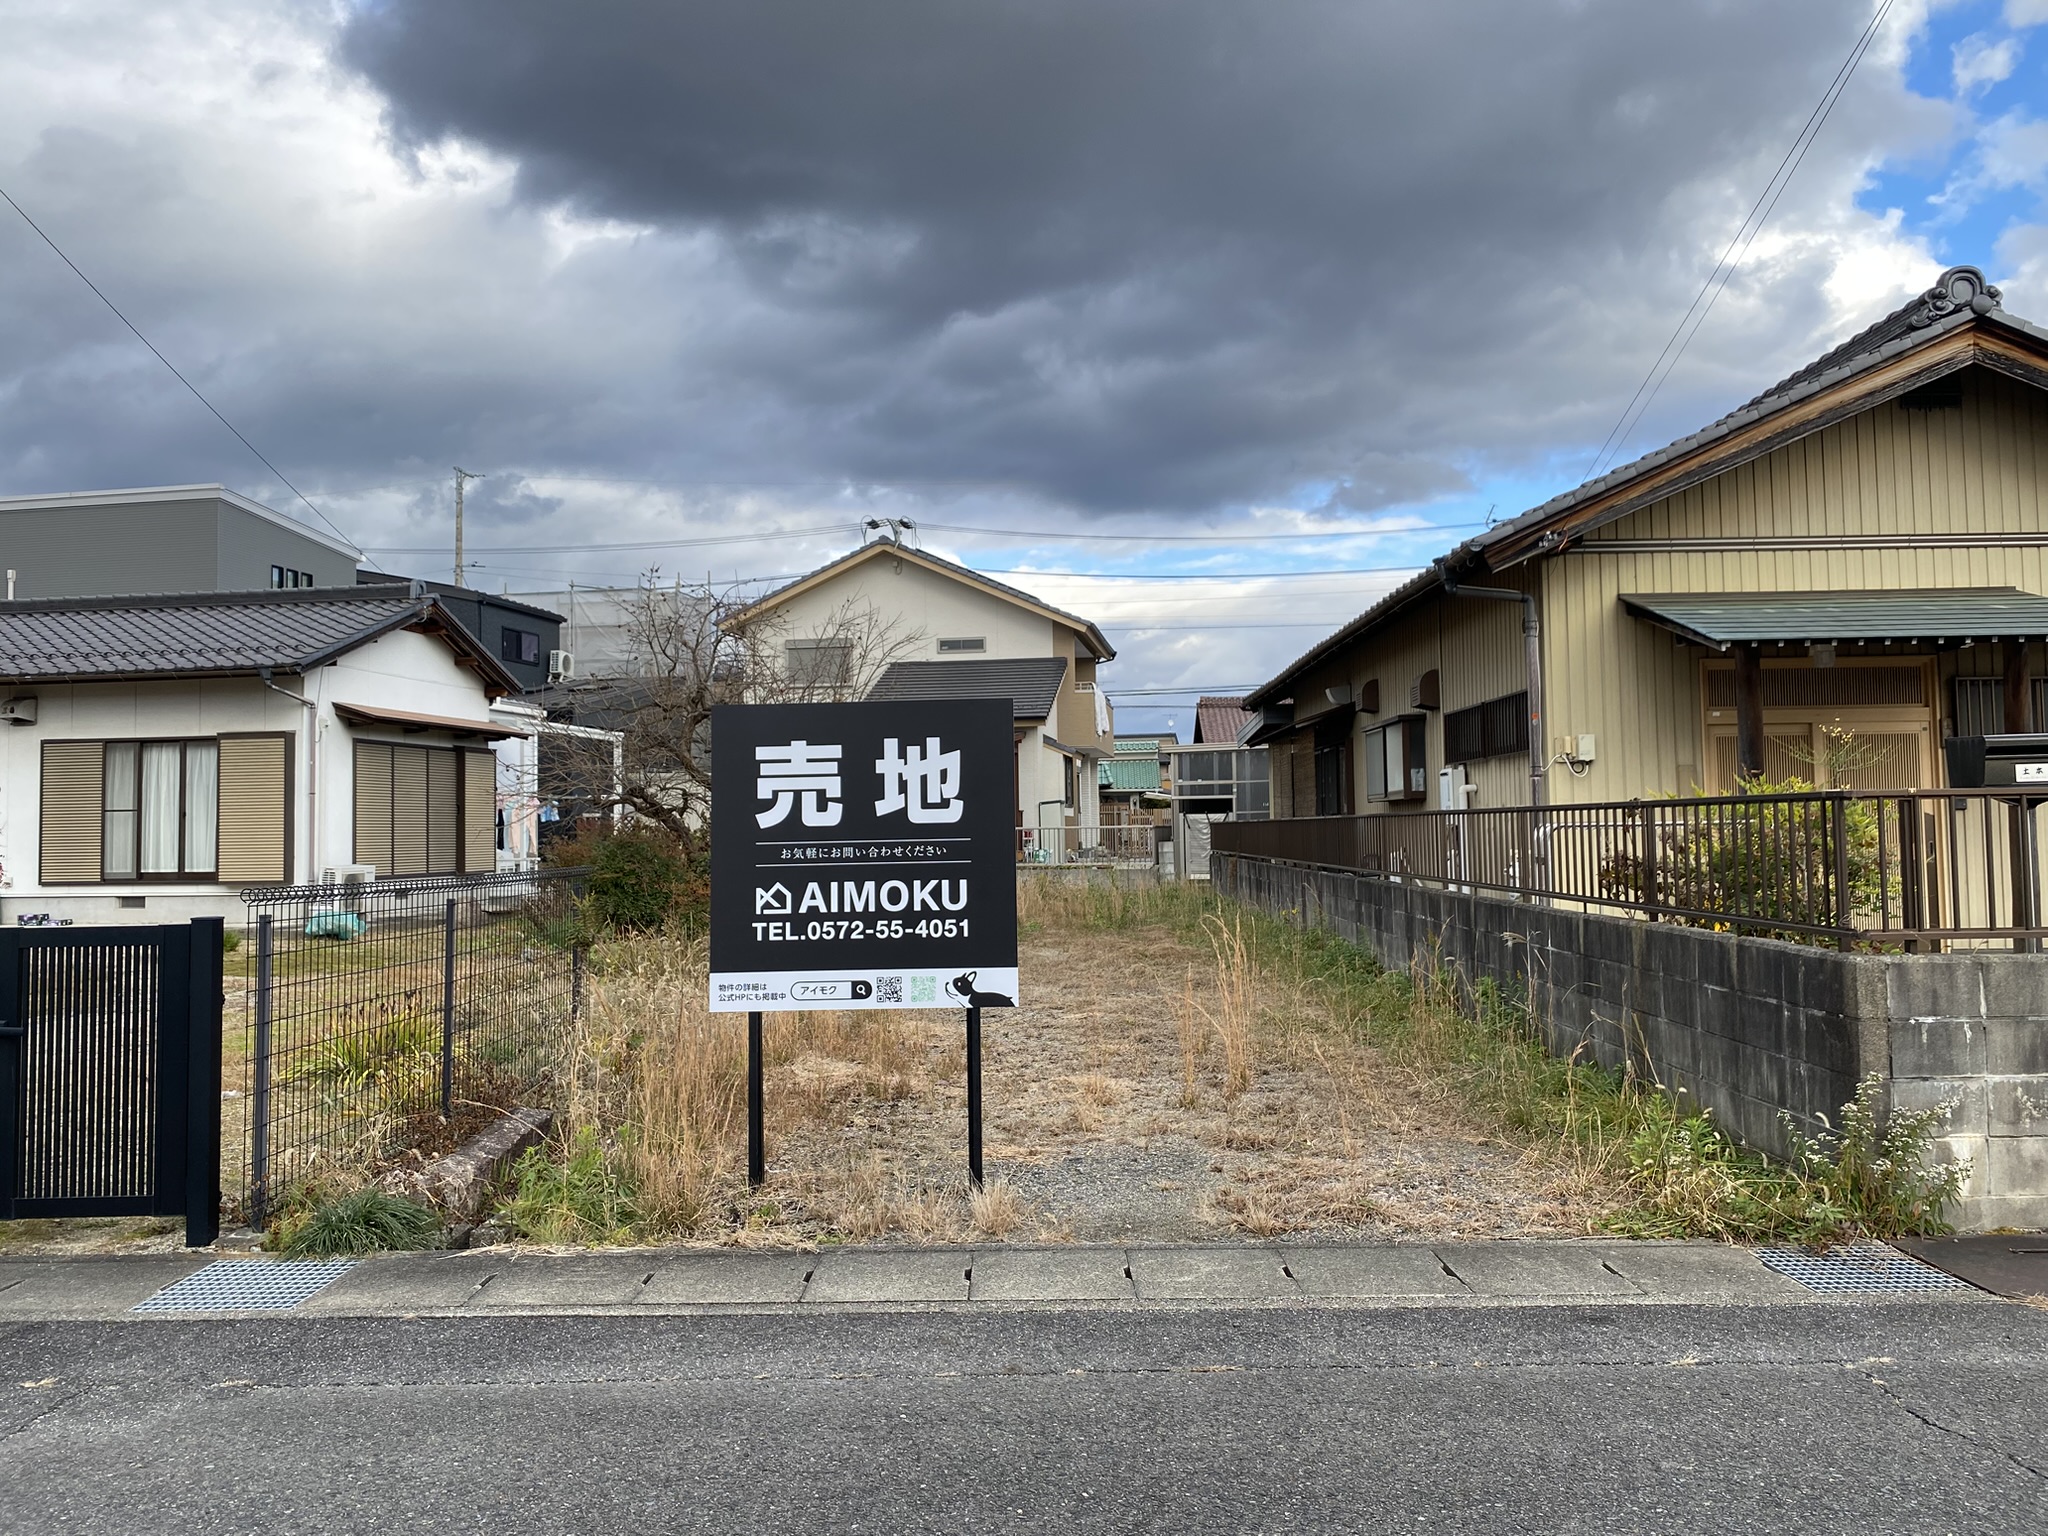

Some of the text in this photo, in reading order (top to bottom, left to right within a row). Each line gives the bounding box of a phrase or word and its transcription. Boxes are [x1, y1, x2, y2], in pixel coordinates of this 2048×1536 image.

[754, 736, 964, 830] 売地
[780, 845, 948, 860] お気軽にお問い合わせください
[798, 878, 968, 914] AIMOKU
[751, 918, 970, 942] TEL.0572-55-4051
[718, 983, 768, 993] 物件の詳細は
[800, 985, 838, 996] アイモク
[718, 992, 787, 1002] 公式HPにも掲載中
